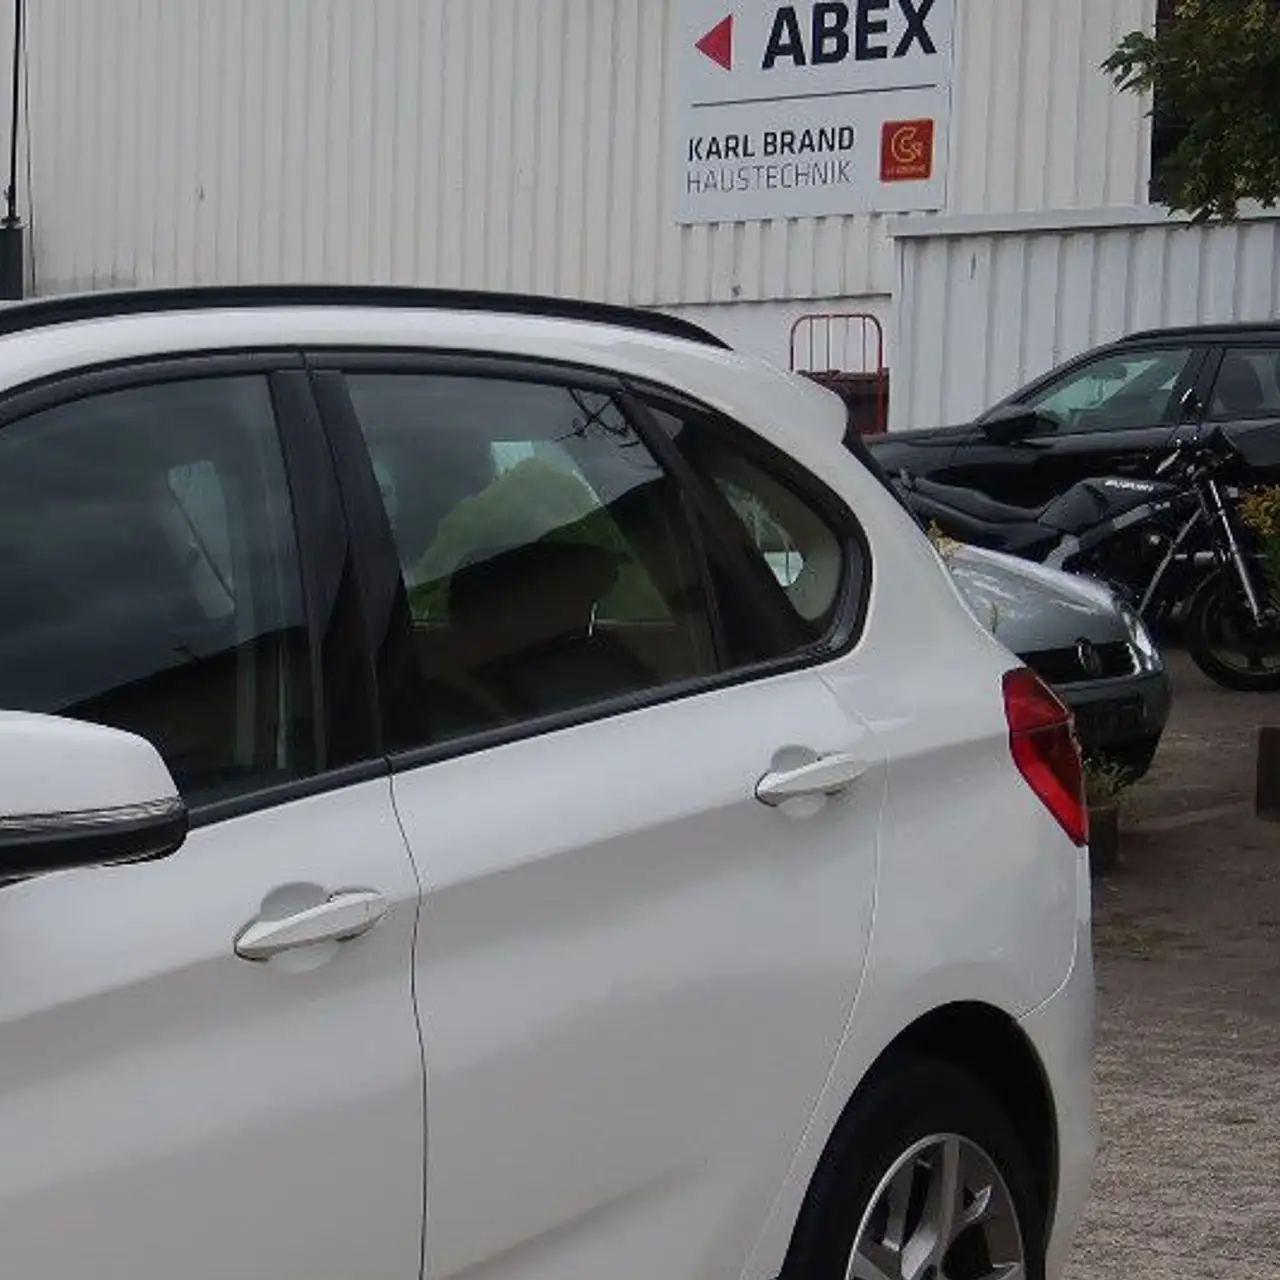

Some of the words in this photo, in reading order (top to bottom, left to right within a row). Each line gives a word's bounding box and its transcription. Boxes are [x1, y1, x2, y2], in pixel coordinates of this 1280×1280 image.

[762, 0, 937, 69] ABEX
[688, 134, 755, 161] KARL
[764, 126, 854, 156] BRAND
[687, 160, 852, 194] HAUSTECHNIK
